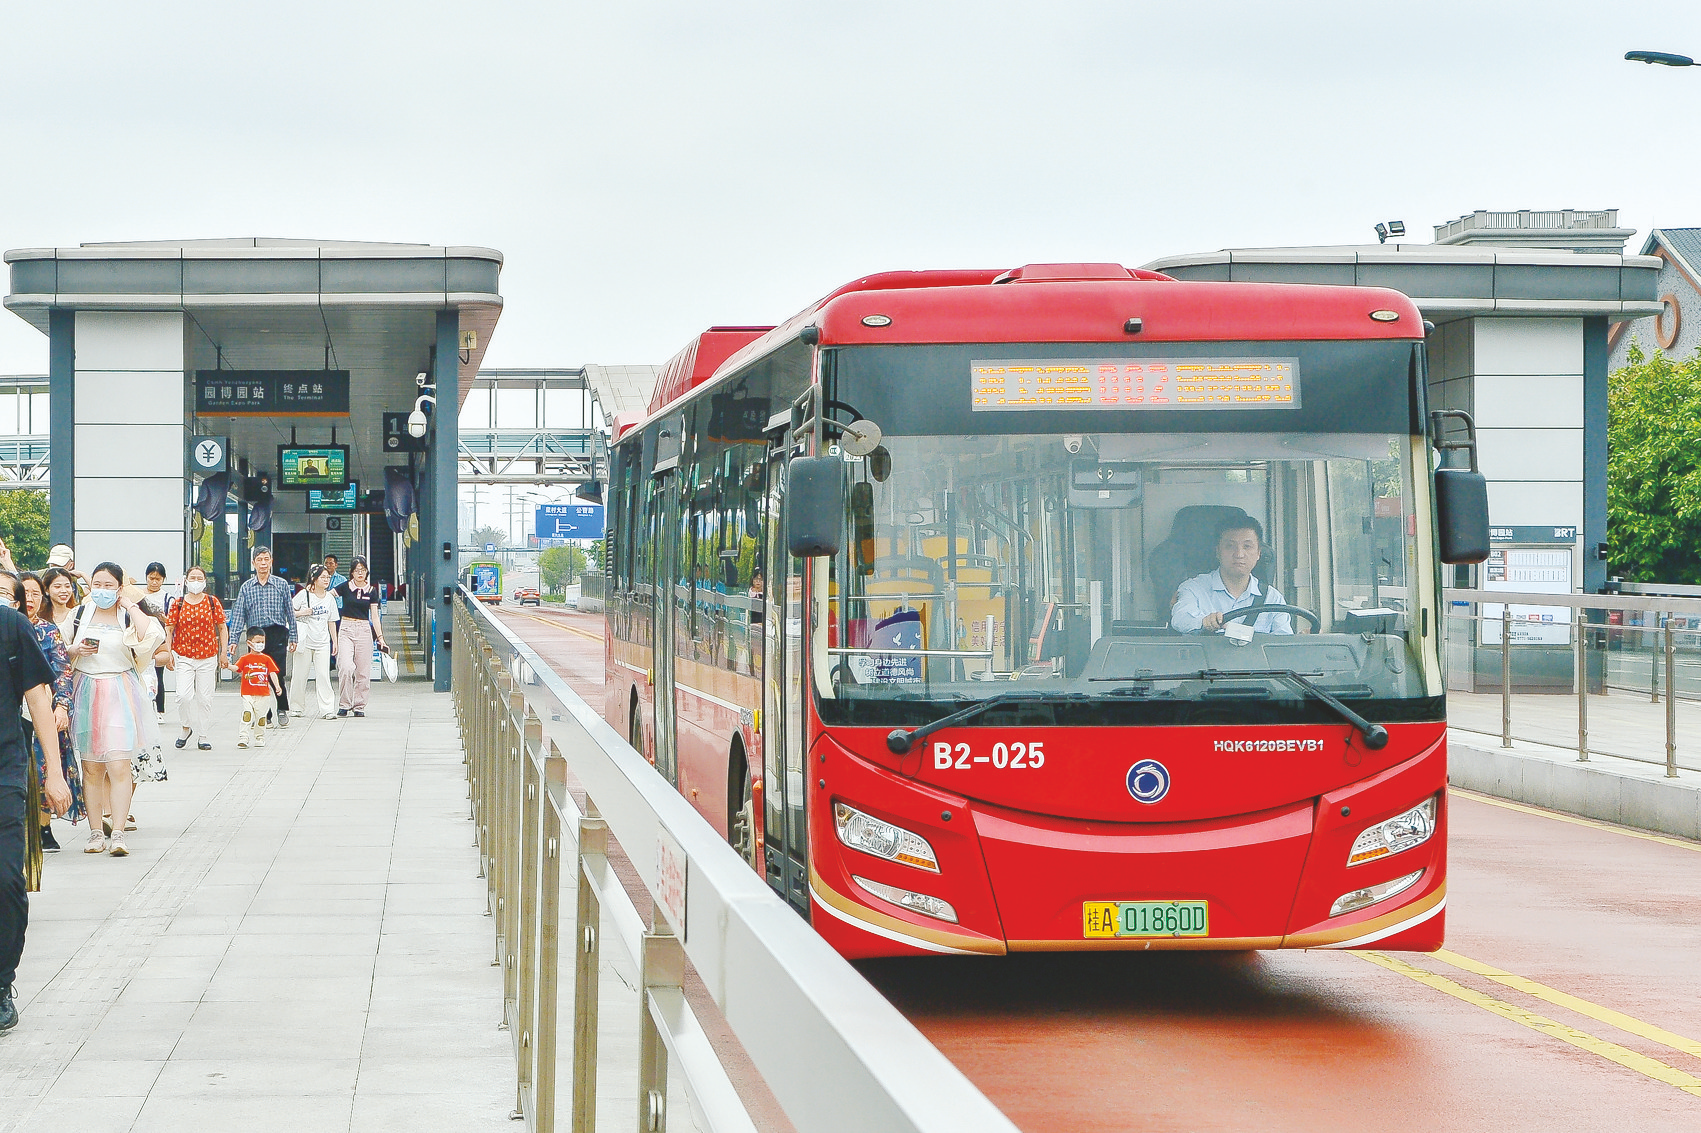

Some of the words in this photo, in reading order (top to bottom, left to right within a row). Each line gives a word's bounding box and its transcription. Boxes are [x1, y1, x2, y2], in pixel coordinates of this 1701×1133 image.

[204, 386, 265, 399] 园博园站
[283, 383, 323, 394] 终点站
[1213, 739, 1324, 753] HQK6120BEVB1
[933, 741, 1045, 770] B2-025
[1087, 907, 1114, 933] 桂A
[1124, 906, 1206, 932] 01860D
